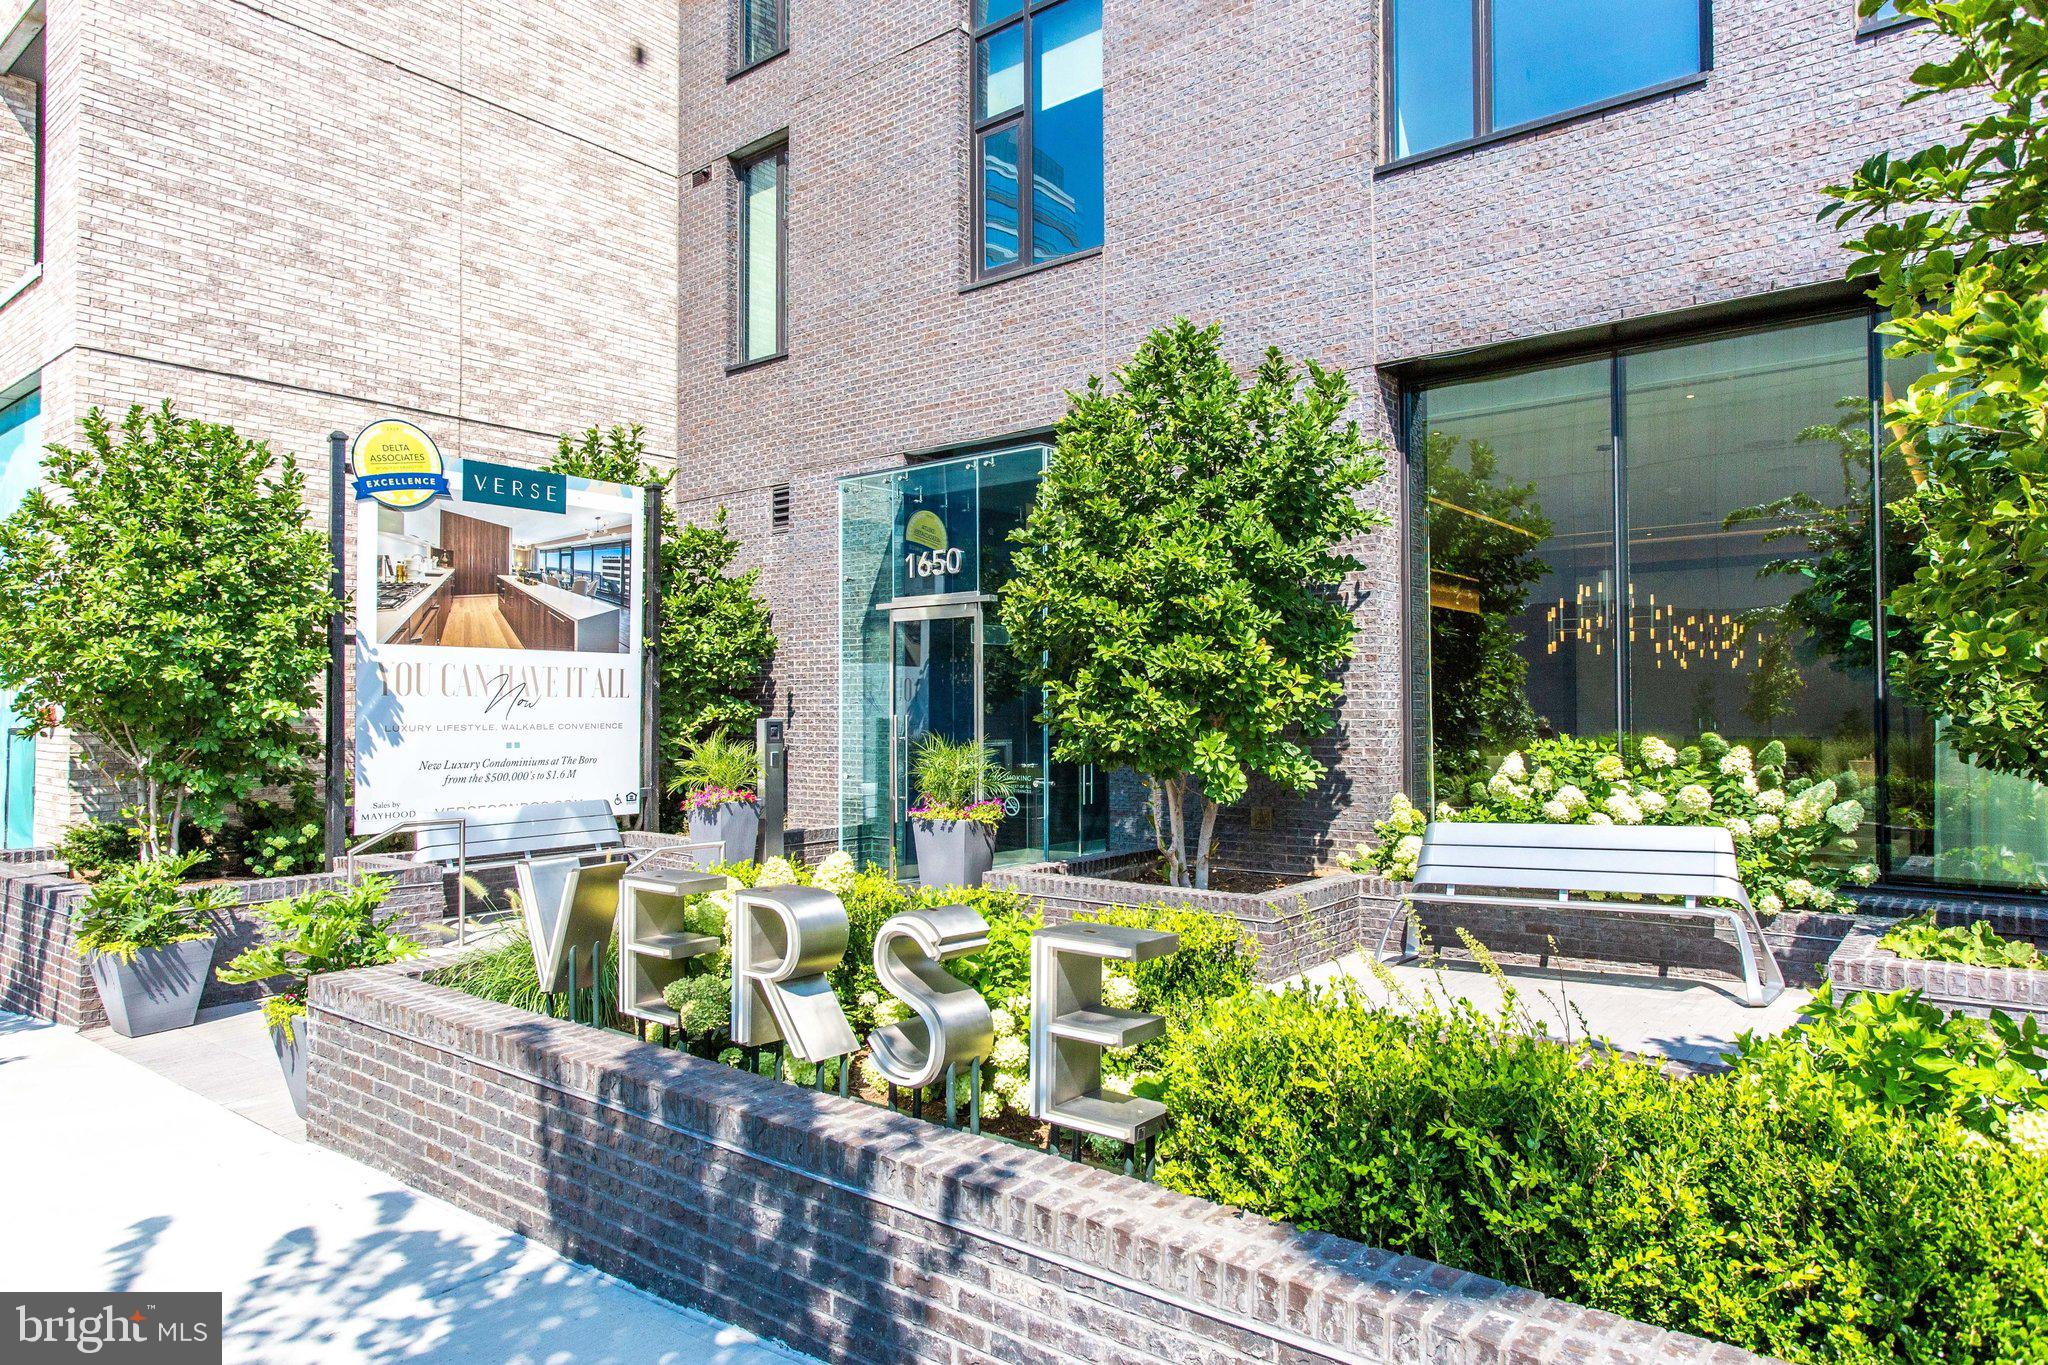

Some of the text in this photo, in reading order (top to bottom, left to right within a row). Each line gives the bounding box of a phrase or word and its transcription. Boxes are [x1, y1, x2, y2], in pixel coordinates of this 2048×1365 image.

[382, 444, 410, 452] DELTA
[370, 453, 425, 462] ASSOCIATES
[366, 477, 436, 488] EXCELLENCE
[473, 474, 557, 502] VERSE
[905, 547, 962, 578] 1650
[378, 661, 630, 698] YOU CAN HAVE IT ALL
[484, 673, 541, 720] Now
[385, 724, 432, 732] LUXURY
[501, 723, 554, 731] WALKABLE
[558, 722, 623, 730] CONVENIENCE
[418, 755, 598, 771] New Luxury Condominiums at The Boro
[442, 774, 466, 786] from
[468, 774, 483, 783] the
[536, 772, 544, 780] to
[545, 769, 565, 780] $1.6
[566, 769, 577, 779] M
[372, 801, 400, 809] Sales by
[361, 810, 417, 821] MAYHOOD
[514, 857, 1180, 1144] VERSE
